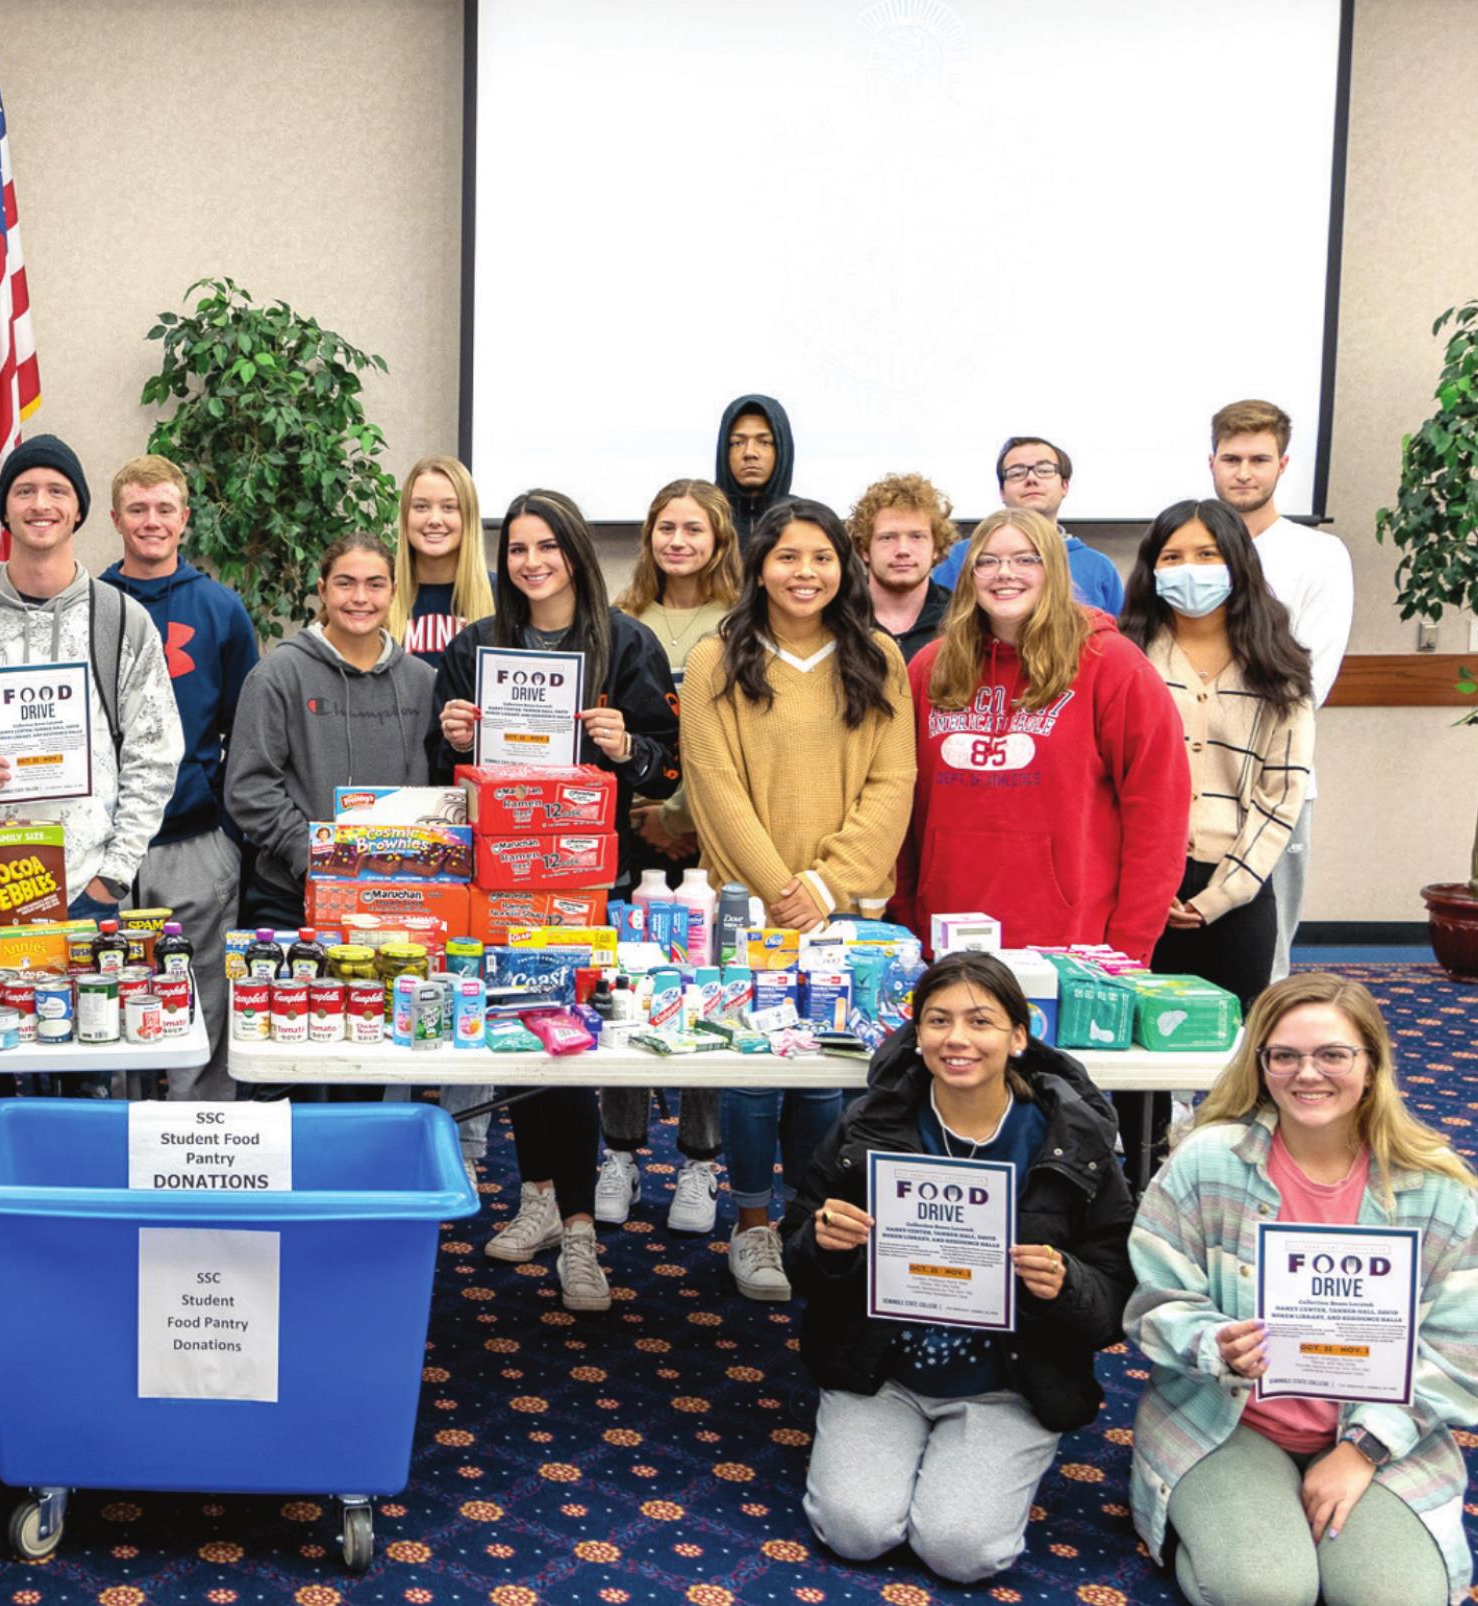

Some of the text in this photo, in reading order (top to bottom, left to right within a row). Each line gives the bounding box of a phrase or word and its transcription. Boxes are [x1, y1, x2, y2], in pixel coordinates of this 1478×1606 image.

[497, 670, 564, 686] FOOD
[4, 685, 72, 704] FOOD
[512, 686, 546, 702] DRIVE
[21, 703, 56, 720] DRIVE
[1009, 713, 1056, 737] EAGLE
[971, 738, 1007, 766] 85
[503, 800, 543, 809] Ramen
[545, 804, 561, 818] 12
[25, 832, 44, 840] SIZE
[367, 828, 418, 839] Cosmic
[356, 838, 428, 852] Brownies
[500, 840, 538, 849] Maruchan
[501, 853, 540, 862] Ramen
[543, 853, 560, 869] 12
[372, 890, 422, 898] Maruchan
[128, 920, 164, 930] SPAM
[724, 914, 744, 922] Dove
[511, 932, 531, 940] GLAD
[511, 966, 570, 986] Coast
[196, 1112, 226, 1124] SSC
[160, 1132, 260, 1145] Student Food
[186, 1152, 236, 1168] Pantry
[153, 1174, 269, 1189] DONATIONS
[896, 1180, 989, 1205] FOOD
[917, 1202, 964, 1223] DRIVE
[1288, 1253, 1392, 1276] FOOD
[196, 1272, 221, 1284] SSC
[1312, 1276, 1364, 1298] DRIVE
[182, 1294, 234, 1307] Student
[168, 1317, 248, 1332] Food Pantry
[173, 1339, 242, 1352] Donations
